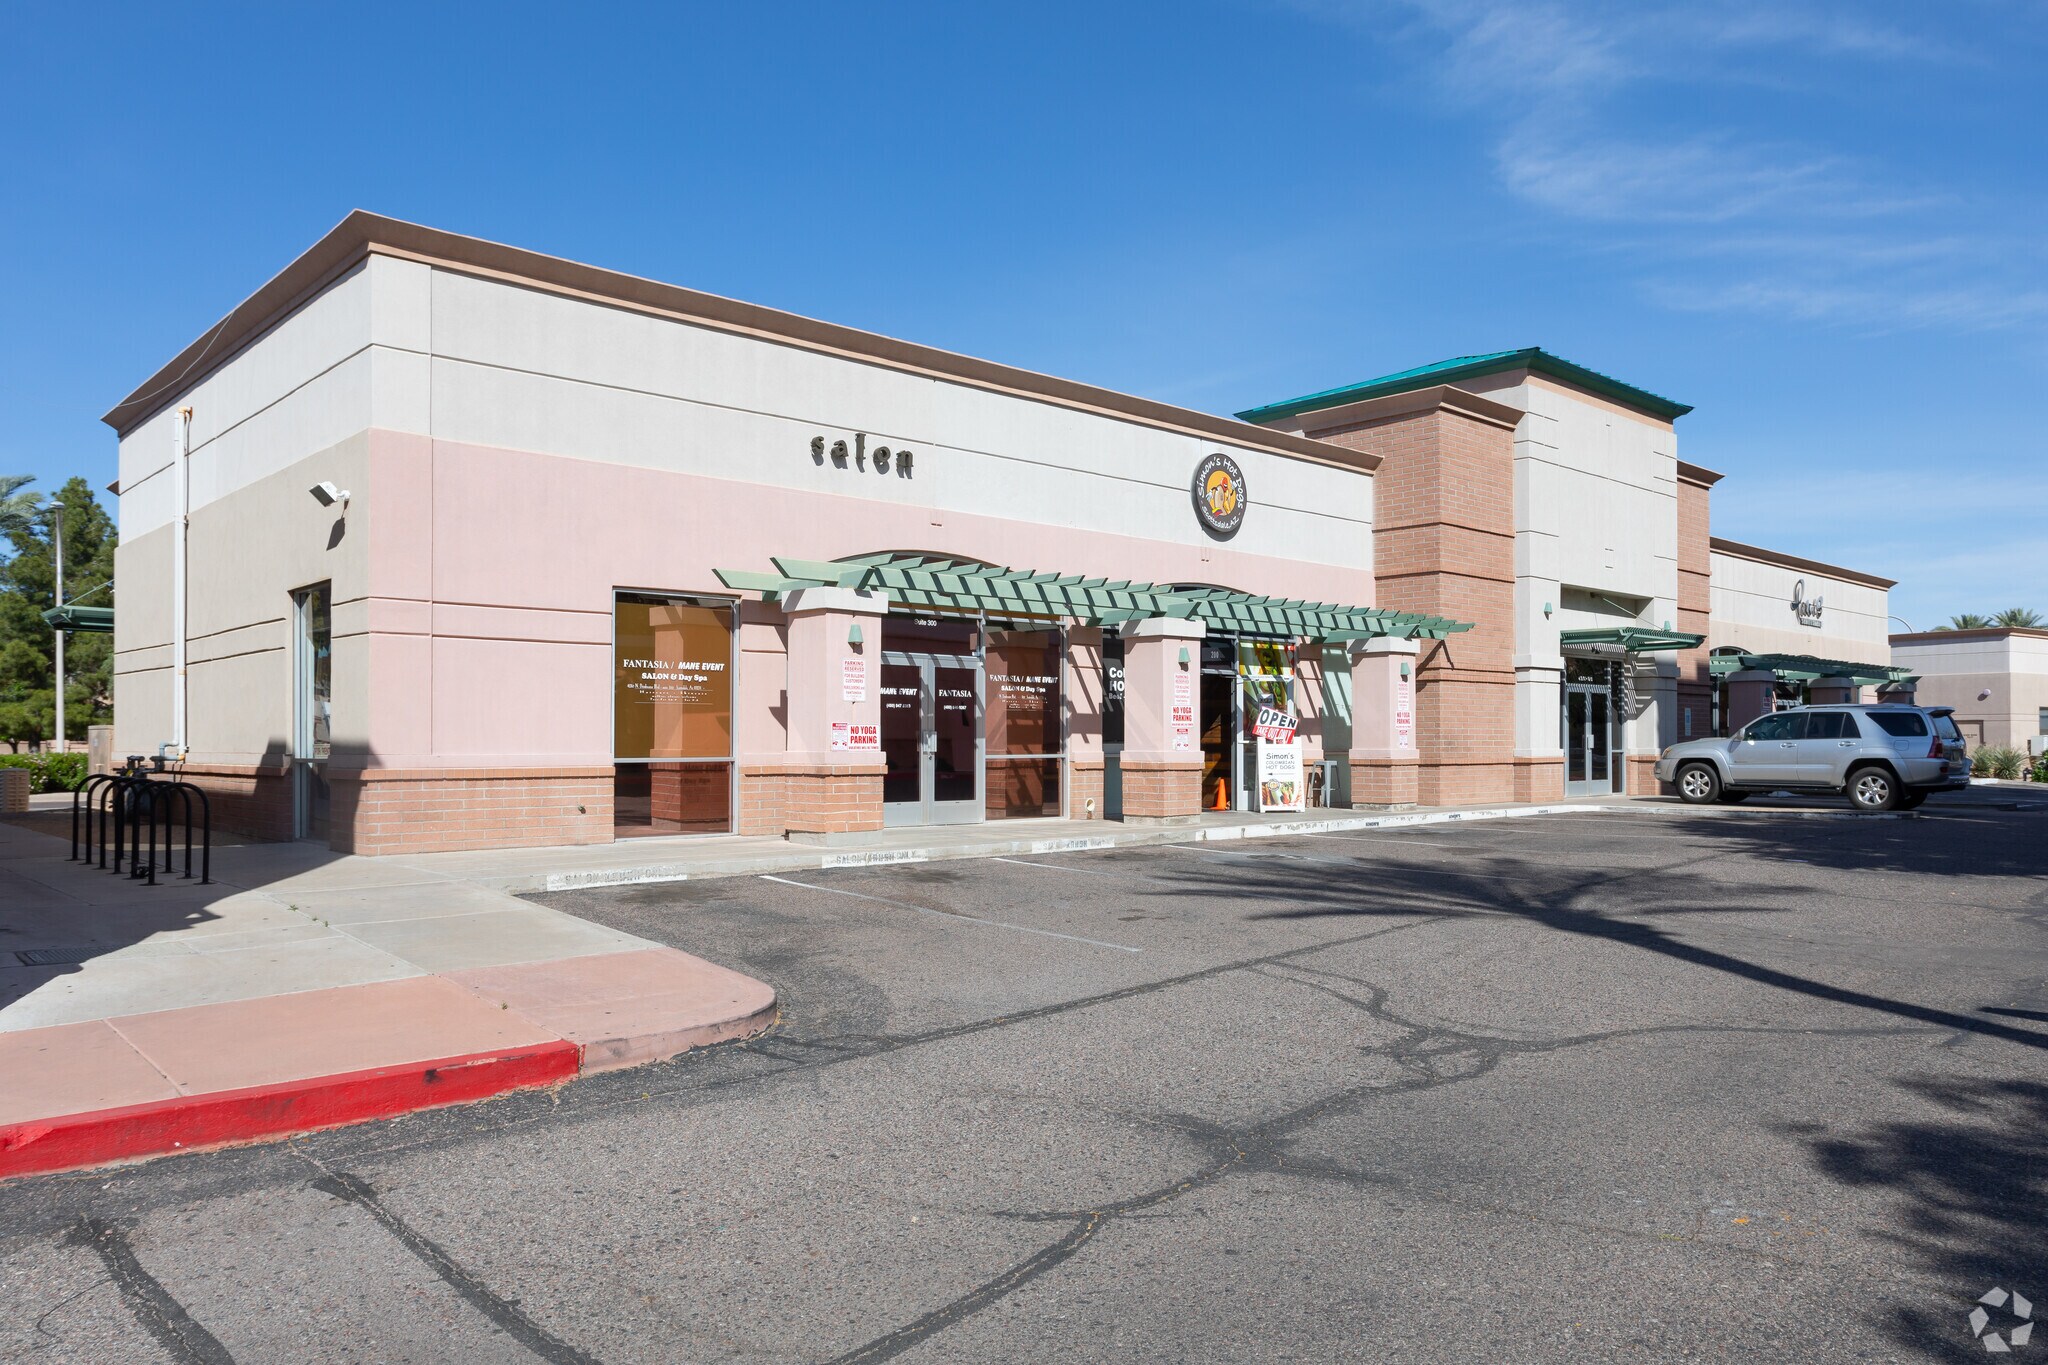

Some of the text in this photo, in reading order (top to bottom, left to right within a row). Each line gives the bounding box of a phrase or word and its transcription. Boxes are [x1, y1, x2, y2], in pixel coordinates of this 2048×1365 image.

[811, 433, 913, 468] salon
[1197, 457, 1244, 509] Simon's Hot Dogs
[927, 619, 937, 627] 300
[623, 659, 669, 669] FANTASIA
[677, 661, 701, 671] MANE
[701, 662, 725, 672] EVENT
[641, 672, 669, 681] SALON
[678, 673, 693, 682] Day
[693, 674, 708, 682] Spa
[989, 674, 1020, 684] FANTASIA
[1042, 676, 1058, 684] EVENT
[880, 687, 917, 696] MANE EVENT
[938, 689, 972, 698] FANTASIA
[1172, 706, 1192, 714] NO YOGA
[1172, 714, 1192, 722] PARKING
[1260, 708, 1297, 728] OPEN
[850, 725, 859, 734] NO
[860, 725, 877, 735] YOGA
[1256, 726, 1269, 736] TAKE
[1267, 727, 1280, 739] OUT
[850, 735, 877, 744] PARKING
[1266, 752, 1294, 760] Simon's
